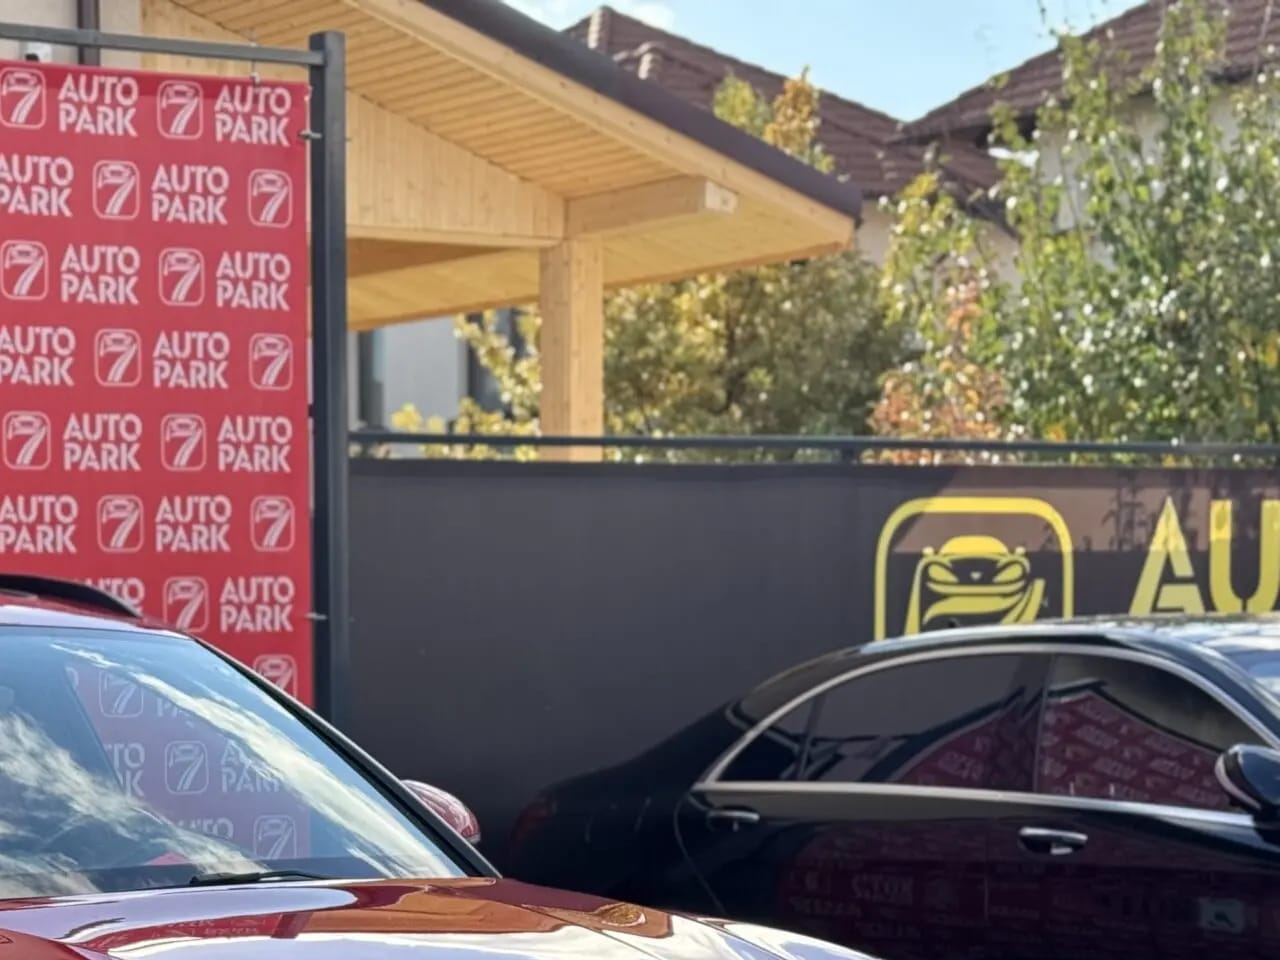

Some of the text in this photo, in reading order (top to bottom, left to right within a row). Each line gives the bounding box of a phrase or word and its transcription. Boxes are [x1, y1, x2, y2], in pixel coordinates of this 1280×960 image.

[58, 74, 138, 106] AUTO
[215, 87, 291, 115] AUTO
[60, 102, 137, 136] PARK
[216, 113, 288, 146] PARK
[152, 165, 229, 194] AUTO
[152, 193, 227, 224] PARK
[61, 245, 139, 275] AUTO
[216, 252, 290, 281] AUTO
[62, 273, 138, 304] PARK
[217, 280, 288, 310] PARK
[153, 331, 229, 359] AUTO
[154, 359, 227, 388] PARK
[64, 414, 142, 442] AUTO
[218, 416, 292, 444] AUTO
[64, 442, 140, 470] PARK
[219, 444, 290, 472] PARK
[156, 495, 231, 523] AUTO
[156, 524, 229, 552] PARK
[220, 576, 294, 603] AUTO
[221, 604, 292, 632] PARK
